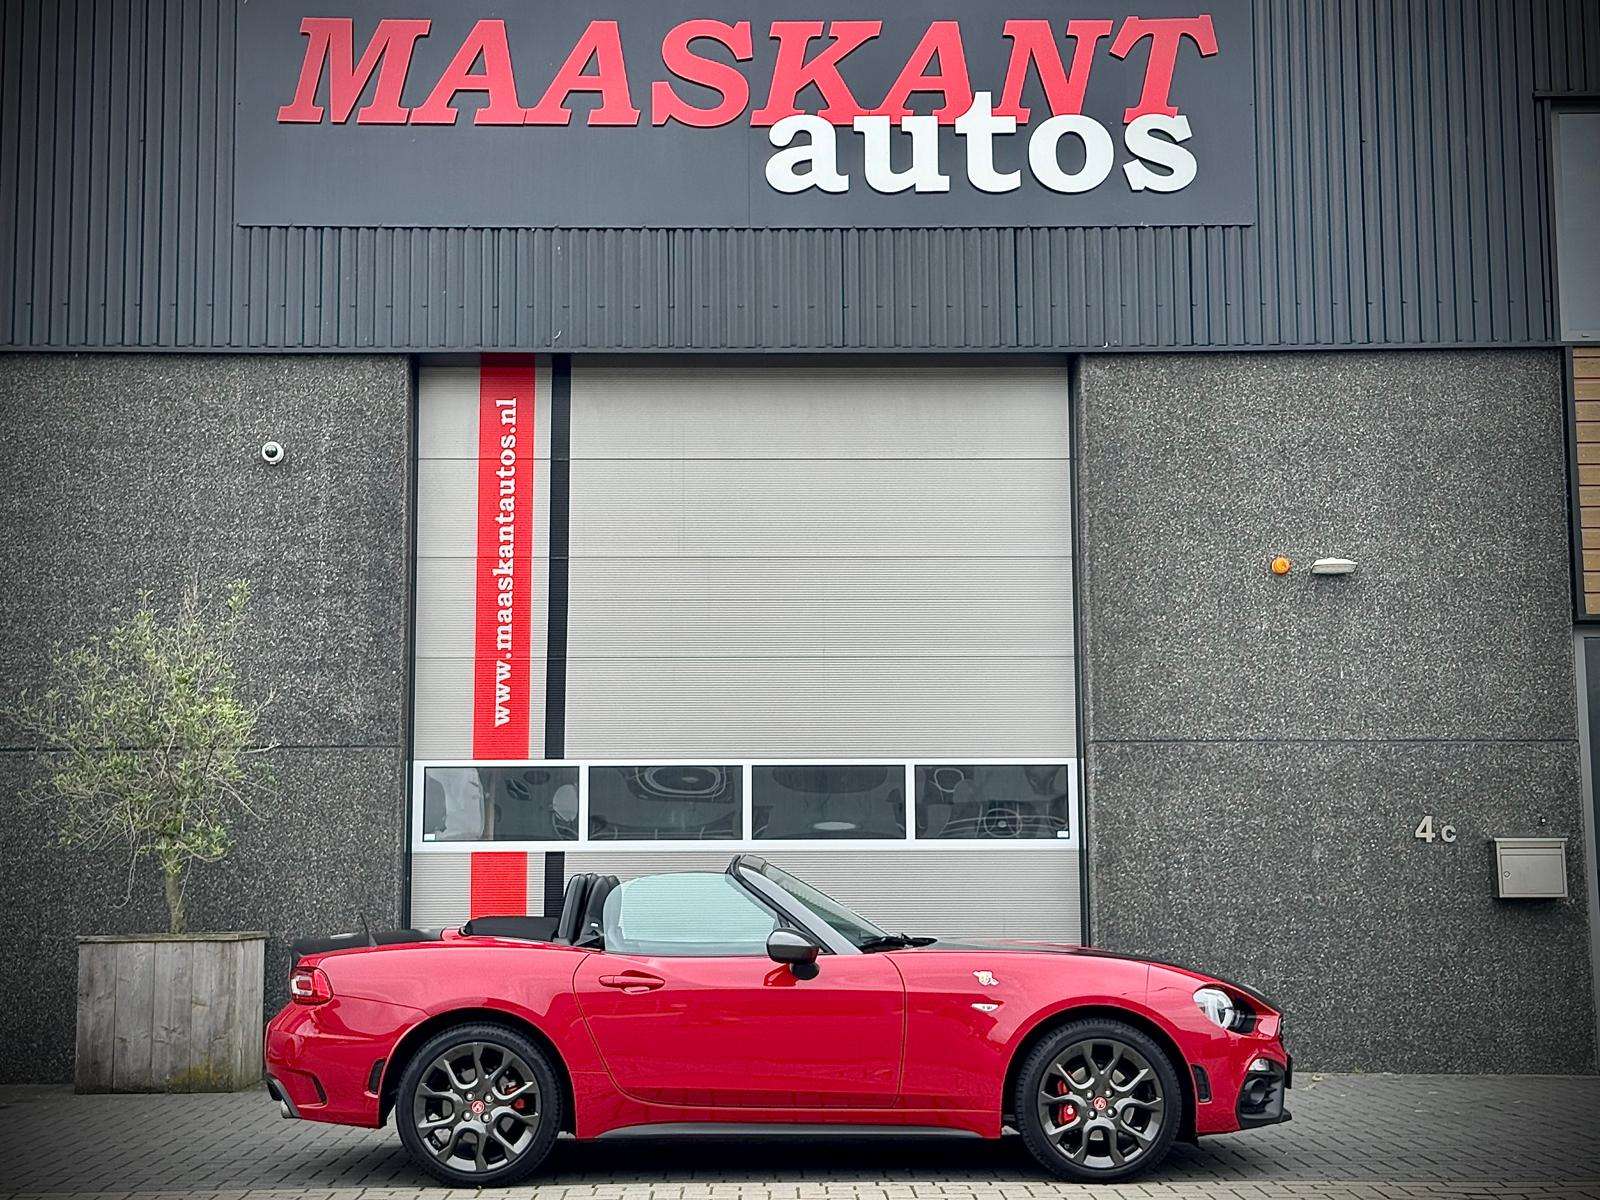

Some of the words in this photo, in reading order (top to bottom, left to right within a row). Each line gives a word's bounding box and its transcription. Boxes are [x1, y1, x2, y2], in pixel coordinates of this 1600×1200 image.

[278, 15, 1218, 126] MAASKANT
[765, 91, 1198, 193] autos
[493, 397, 518, 727] www.maaskantautos.nl
